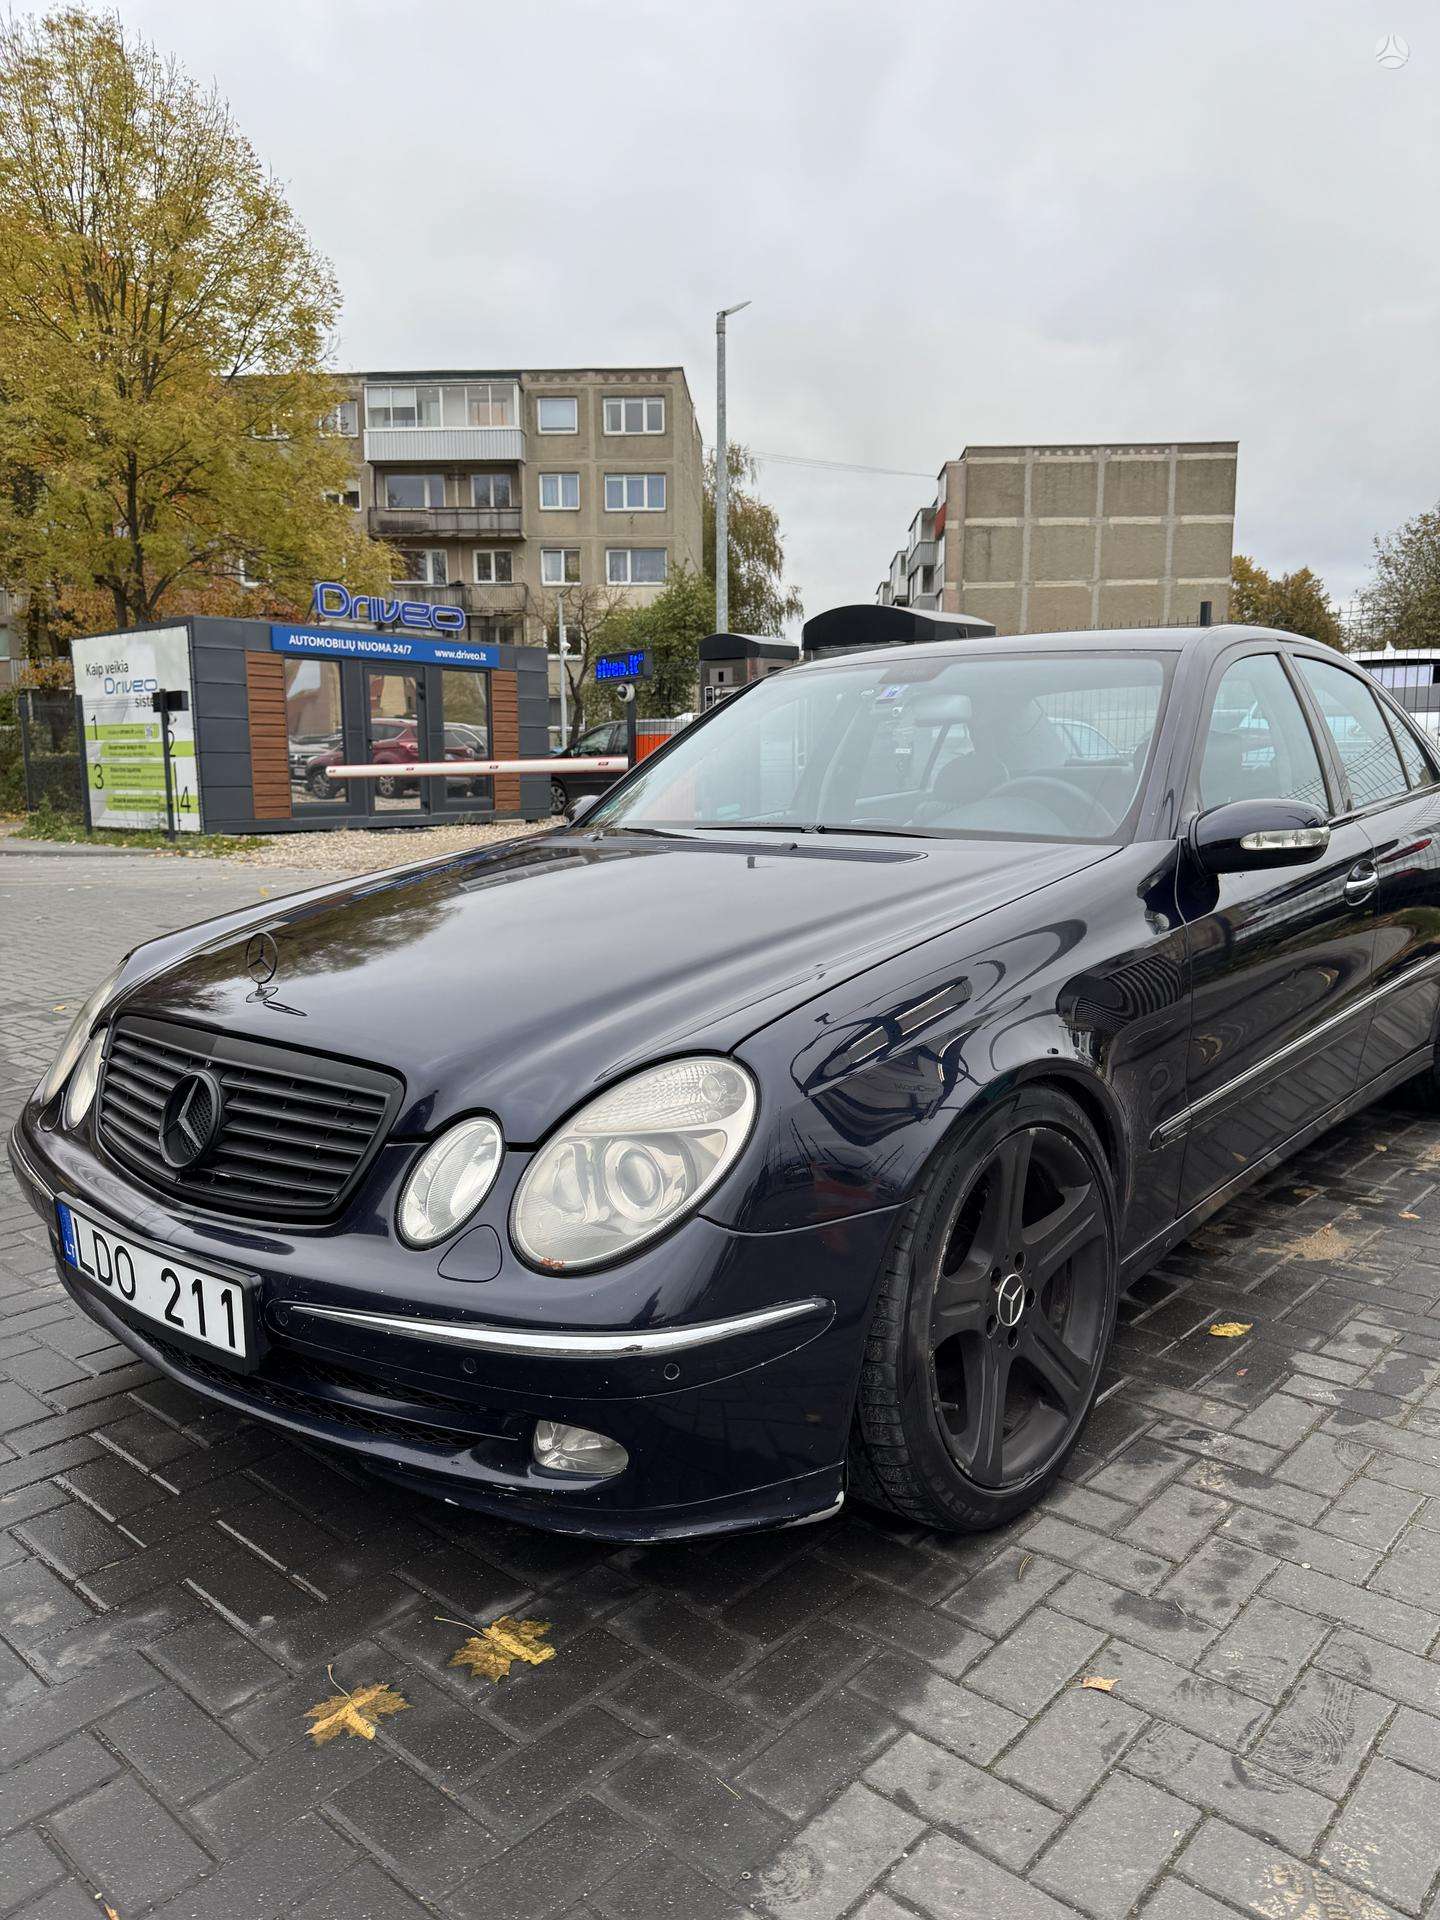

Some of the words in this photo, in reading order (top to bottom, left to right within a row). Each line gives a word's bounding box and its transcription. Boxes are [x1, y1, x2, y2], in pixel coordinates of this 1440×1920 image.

[314, 582, 466, 631] Driveo
[289, 634, 356, 652] AUTOMOBILIŲ
[357, 642, 392, 654] NUOMA
[392, 644, 412, 655] 24/7
[434, 649, 487, 662] www.driveo.lt
[85, 662, 104, 678] Kaip
[105, 660, 129, 675] veikia
[104, 677, 158, 695] Driveo
[134, 696, 153, 708] sist
[91, 714, 98, 740] 1
[167, 729, 176, 757] 2
[94, 763, 104, 790] 3
[180, 786, 191, 814] 4
[65, 1240, 75, 1258] LT
[73, 1216, 136, 1301] LDO
[160, 1267, 236, 1349] 211
